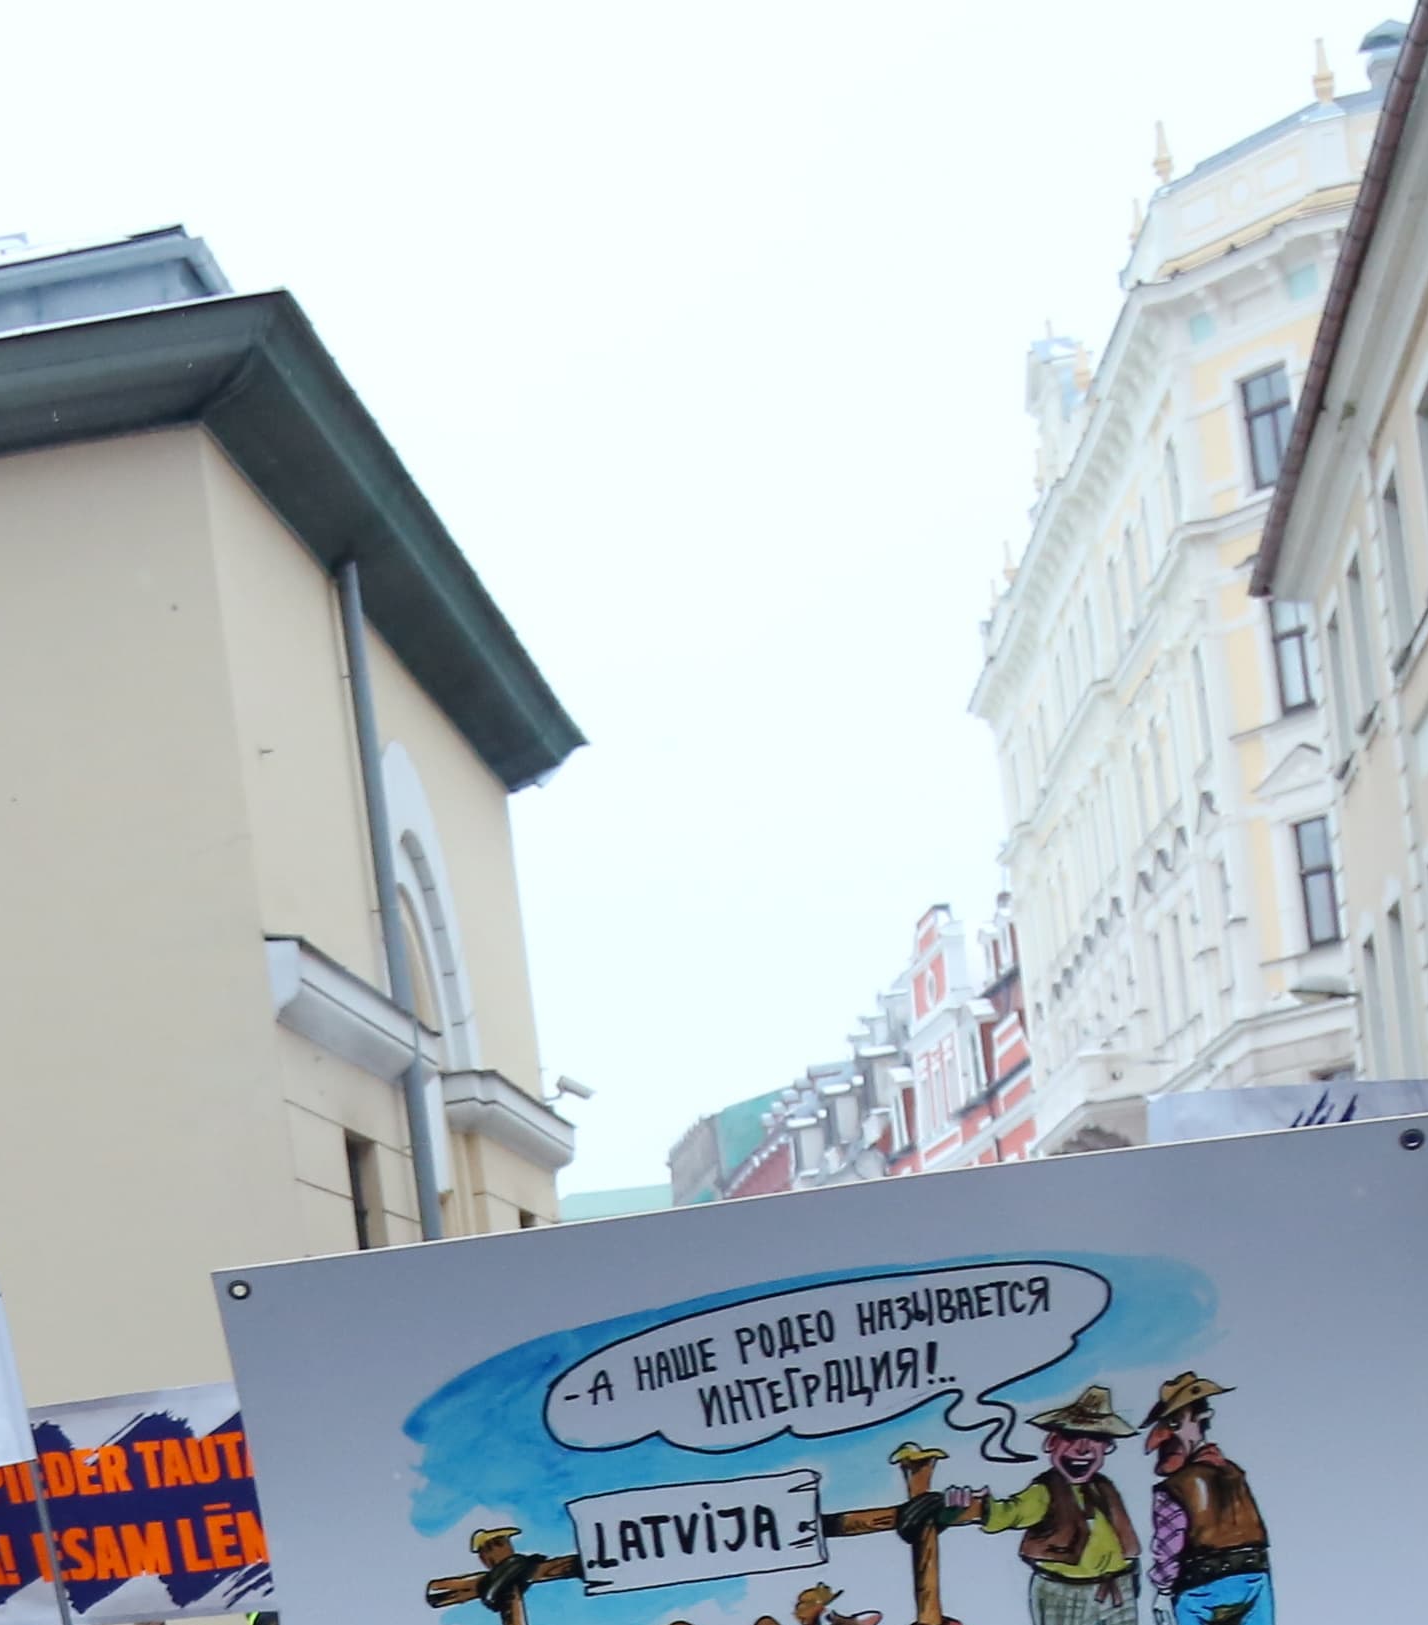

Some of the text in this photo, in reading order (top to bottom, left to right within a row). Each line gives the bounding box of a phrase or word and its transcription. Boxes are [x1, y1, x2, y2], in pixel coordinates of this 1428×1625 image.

[633, 1337, 717, 1392] НАШЕ
[734, 1308, 835, 1365] РОДЕО
[856, 1276, 1052, 1338] НАЗЫВАЕТСЯ
[30, 1521, 174, 1583] ESAM
